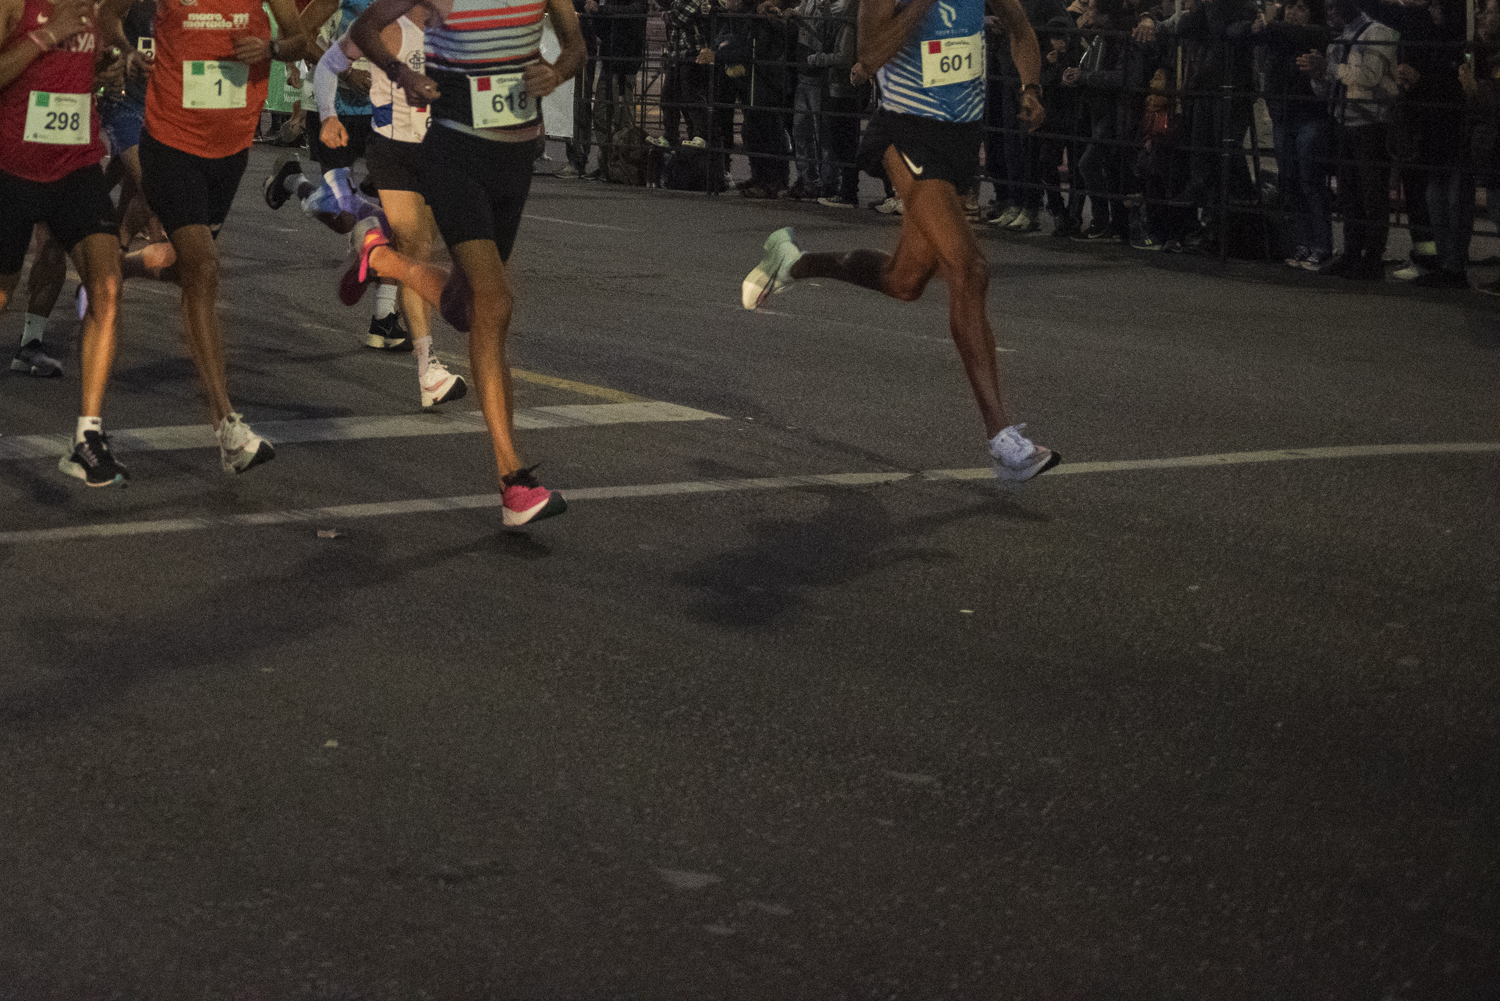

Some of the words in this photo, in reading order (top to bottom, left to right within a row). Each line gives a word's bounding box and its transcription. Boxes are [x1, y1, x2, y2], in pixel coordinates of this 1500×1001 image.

[939, 52, 972, 73] 601
[214, 78, 223, 96] 1
[491, 91, 528, 114] 618
[44, 111, 81, 131] 298
